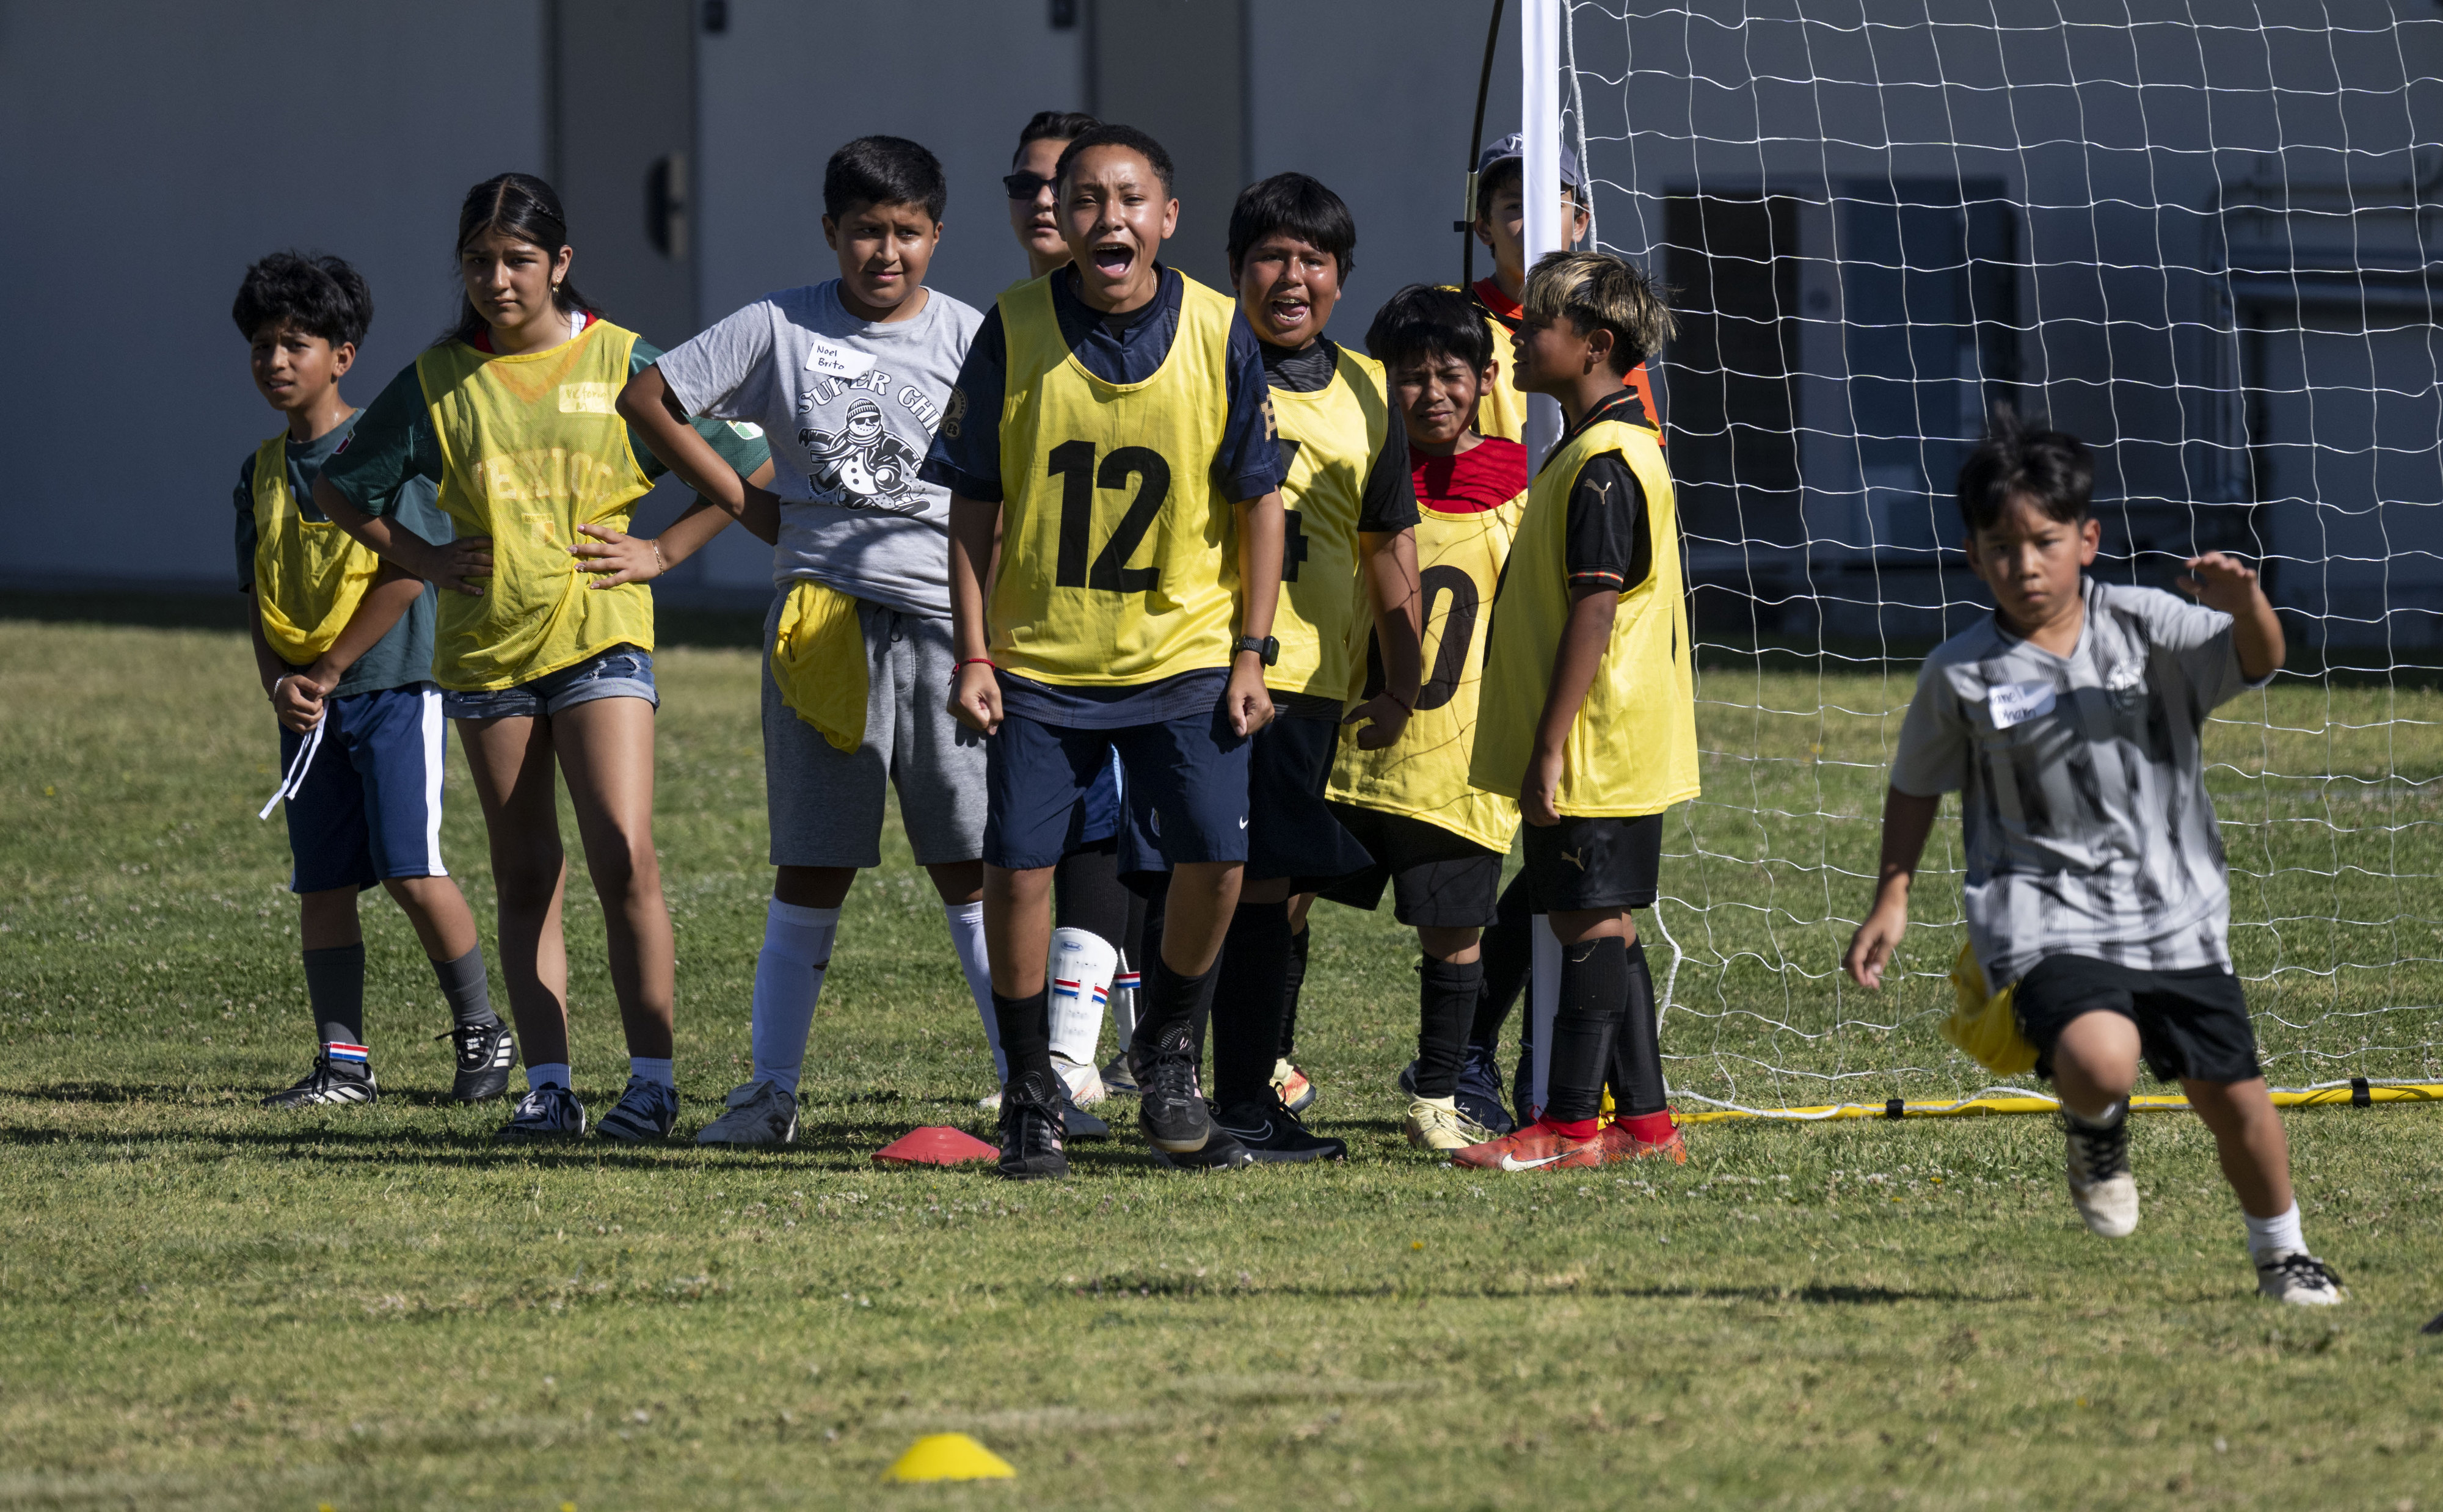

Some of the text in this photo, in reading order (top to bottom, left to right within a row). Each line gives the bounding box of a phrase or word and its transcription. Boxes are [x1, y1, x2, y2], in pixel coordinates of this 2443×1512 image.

[817, 345, 837, 357] Noel
[818, 357, 845, 369] Brito
[798, 369, 892, 415] SUPER
[472, 447, 613, 504] EXICO
[1048, 440, 1171, 592] 12
